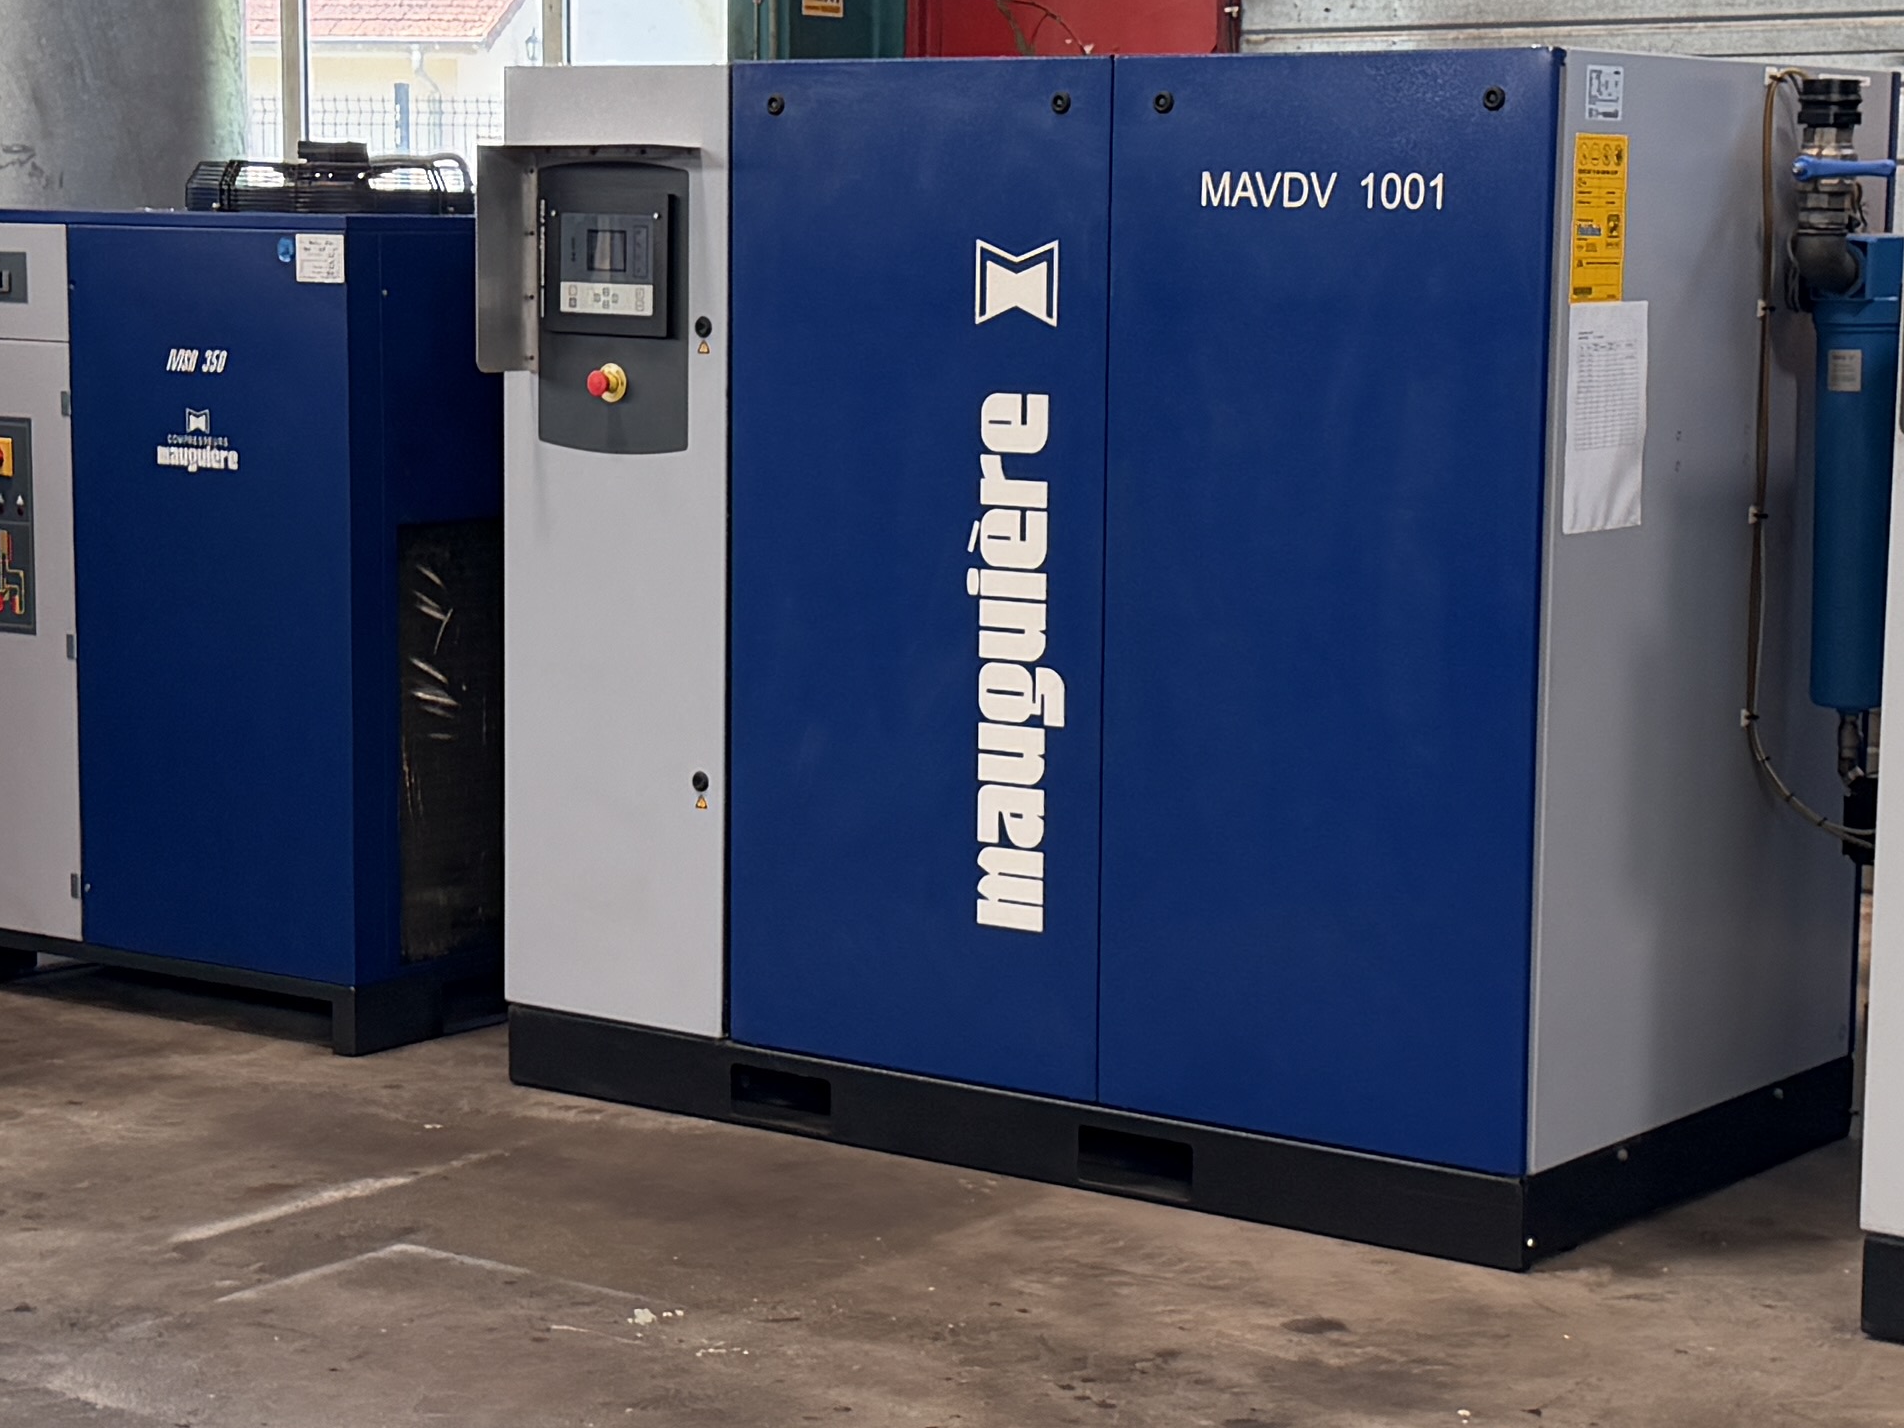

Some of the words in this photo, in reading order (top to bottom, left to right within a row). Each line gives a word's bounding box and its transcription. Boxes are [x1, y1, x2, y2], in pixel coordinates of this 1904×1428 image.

[1200, 171, 1338, 209] MAVDV
[1360, 172, 1445, 210] 1001
[201, 349, 228, 373] 350
[966, 391, 1065, 933] mauguière
